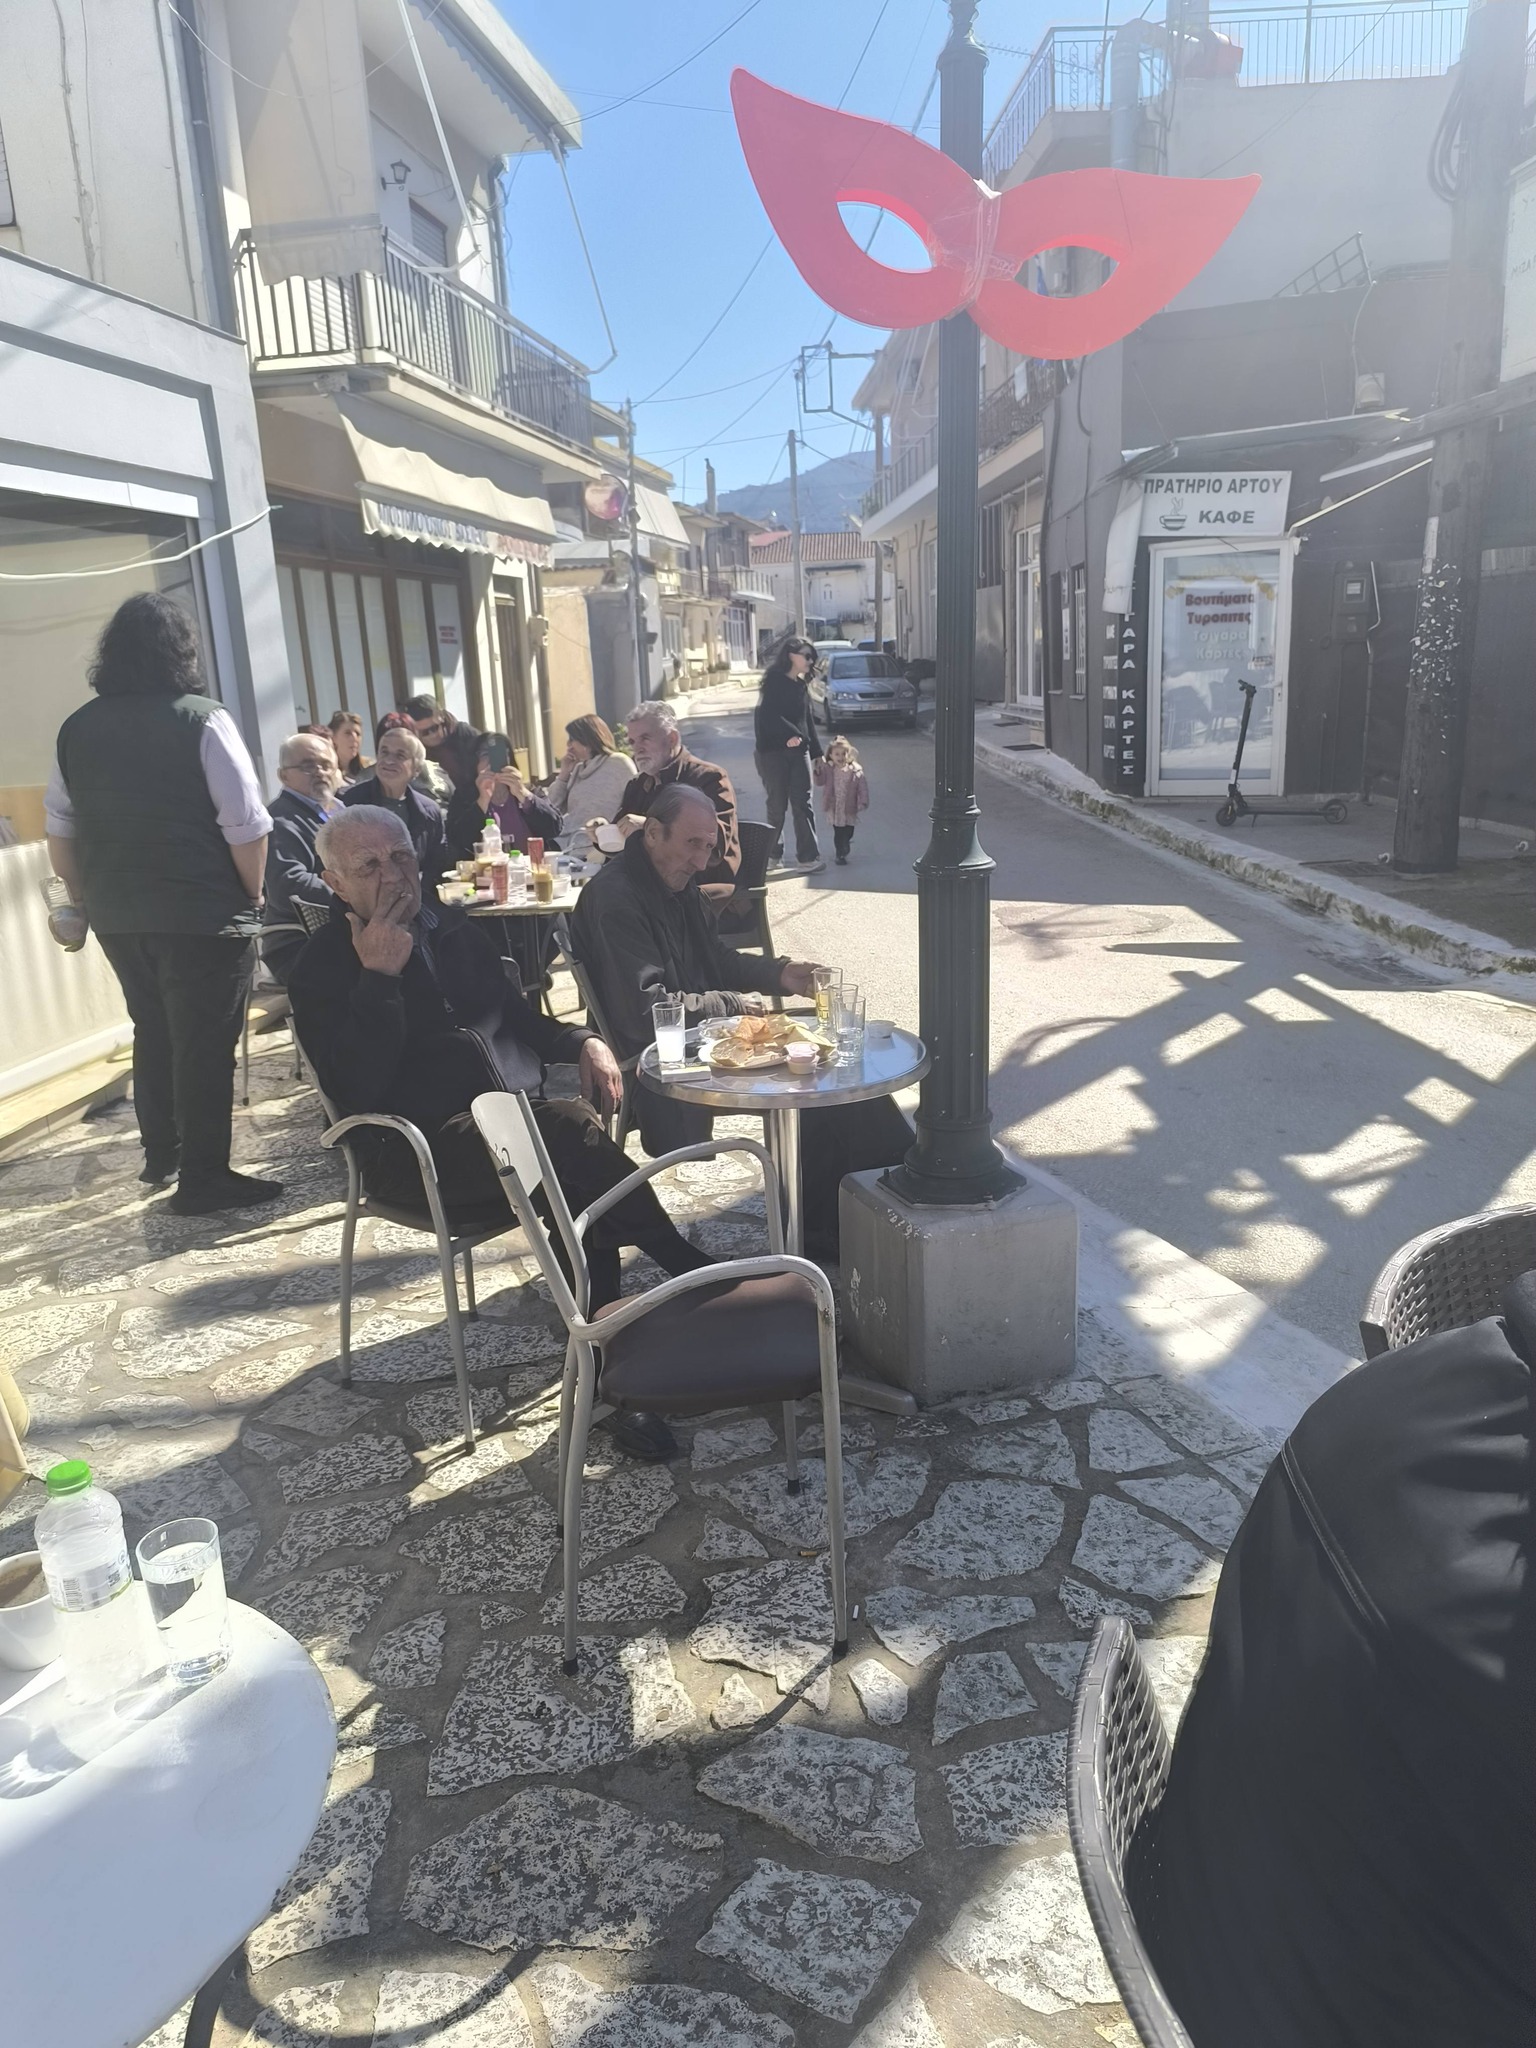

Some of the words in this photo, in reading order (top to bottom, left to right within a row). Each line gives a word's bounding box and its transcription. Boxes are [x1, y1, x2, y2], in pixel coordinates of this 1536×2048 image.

[1143, 478, 1223, 494] ΠΡΑΤΗΡΙΟ
[1226, 477, 1283, 494] ΑΡΤΟΥ
[1198, 510, 1255, 524] ΚΑΦΕ
[1121, 689, 1136, 775] ΚΑΡΤΕΣ
